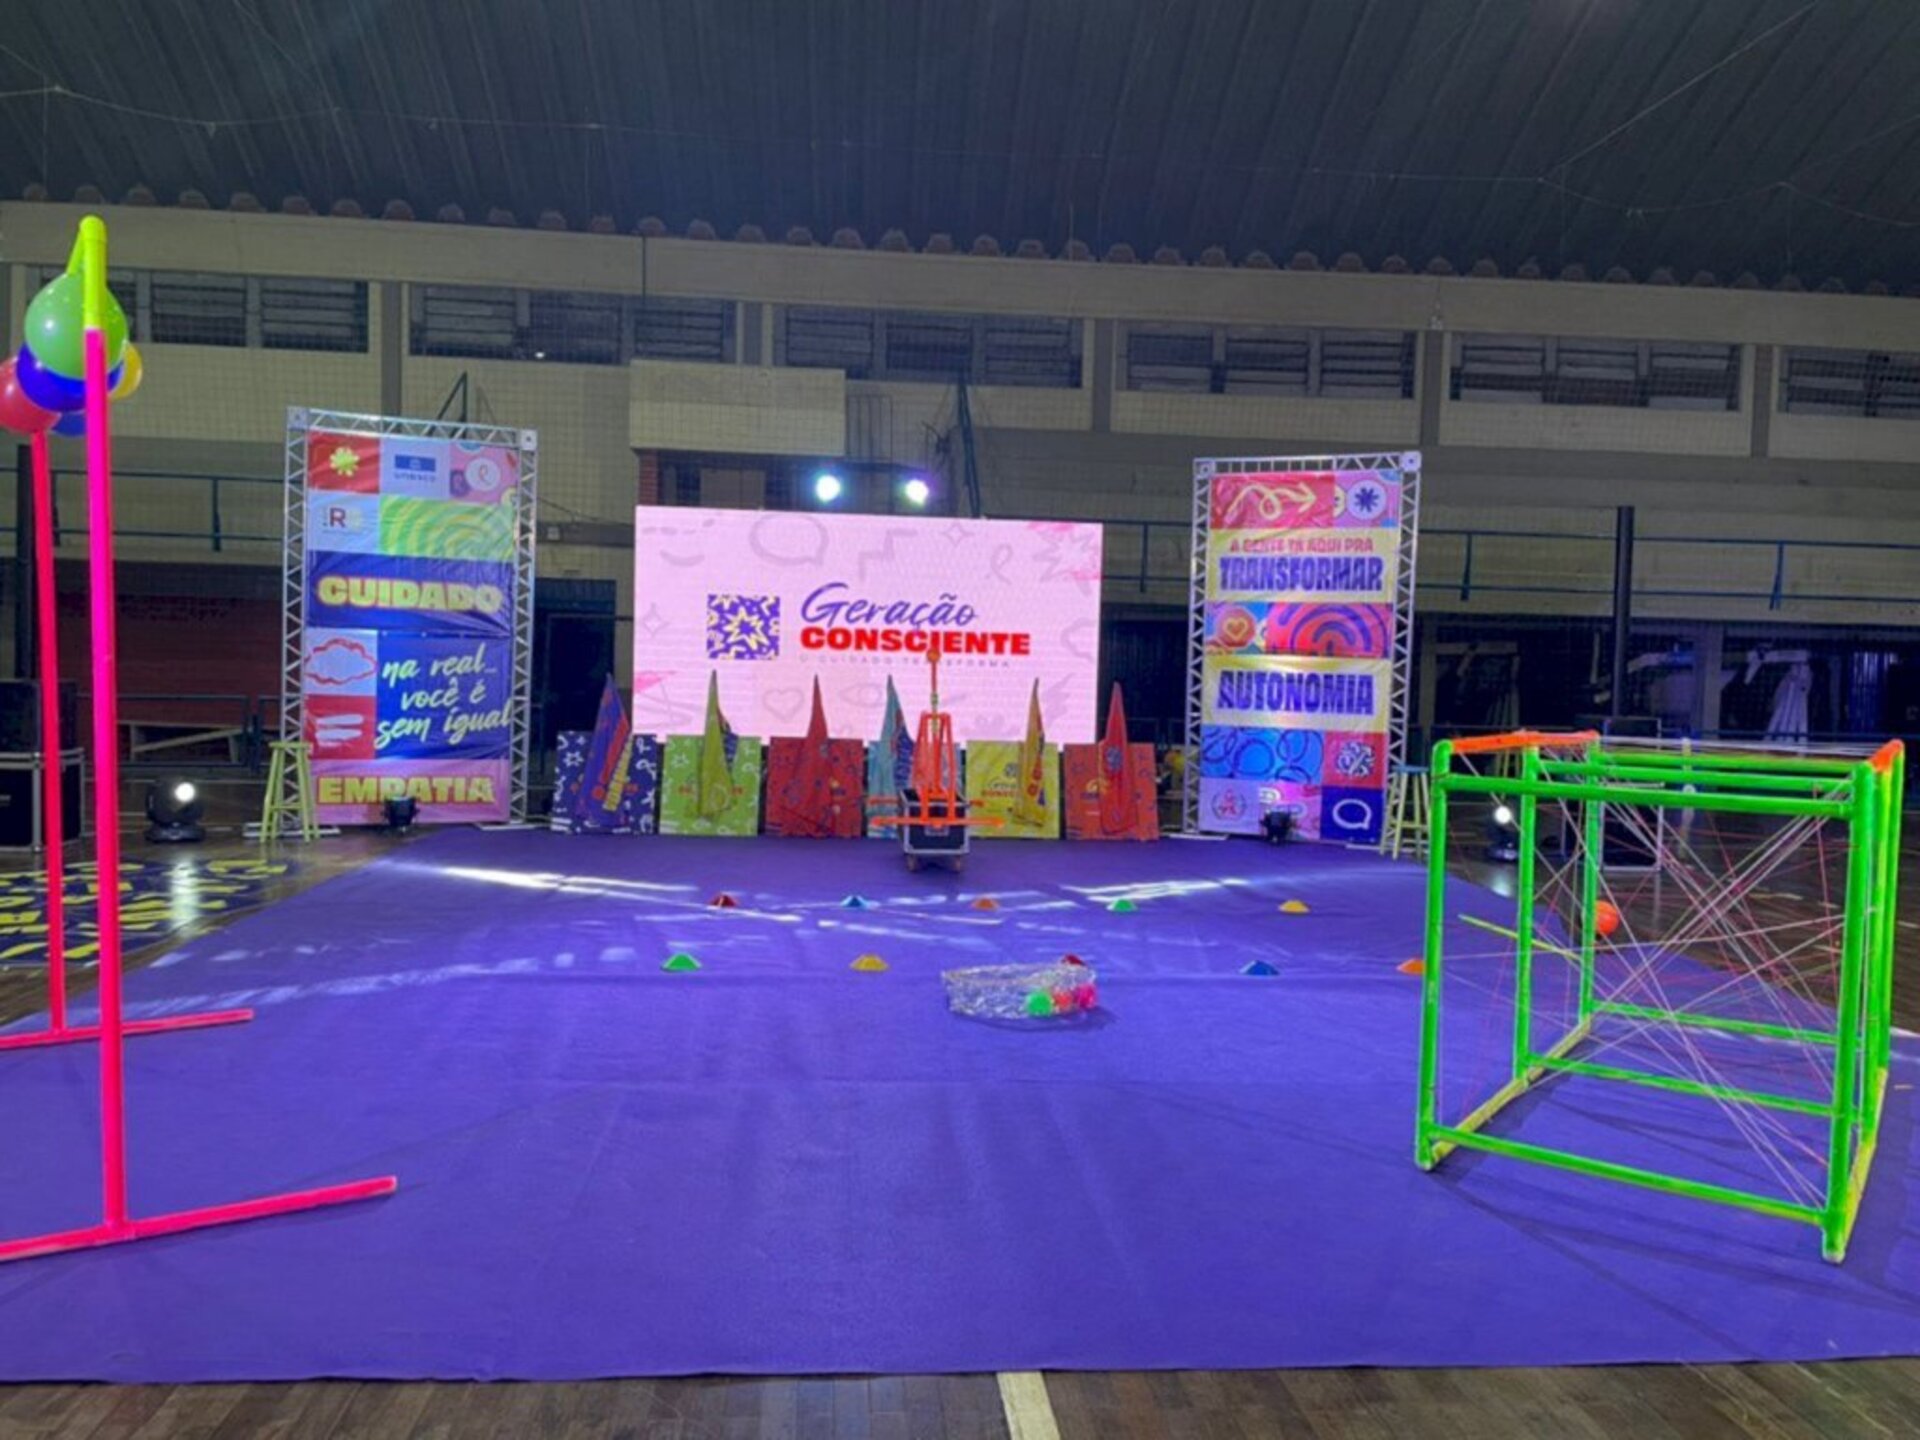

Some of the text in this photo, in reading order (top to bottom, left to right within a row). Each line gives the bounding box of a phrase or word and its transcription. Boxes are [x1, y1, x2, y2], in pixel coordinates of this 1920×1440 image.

[1344, 538, 1374, 552] PRA
[1219, 556, 1384, 591] TRANSFORMAR
[317, 576, 504, 612] CUIDADO
[801, 582, 978, 635] Geração
[801, 627, 1031, 655] CONSCIENTE
[382, 659, 421, 688] na
[401, 676, 487, 711] você é
[1217, 671, 1375, 715] AUTONOMIA
[373, 698, 513, 750] sem igual
[317, 776, 495, 805] EMPATIA
